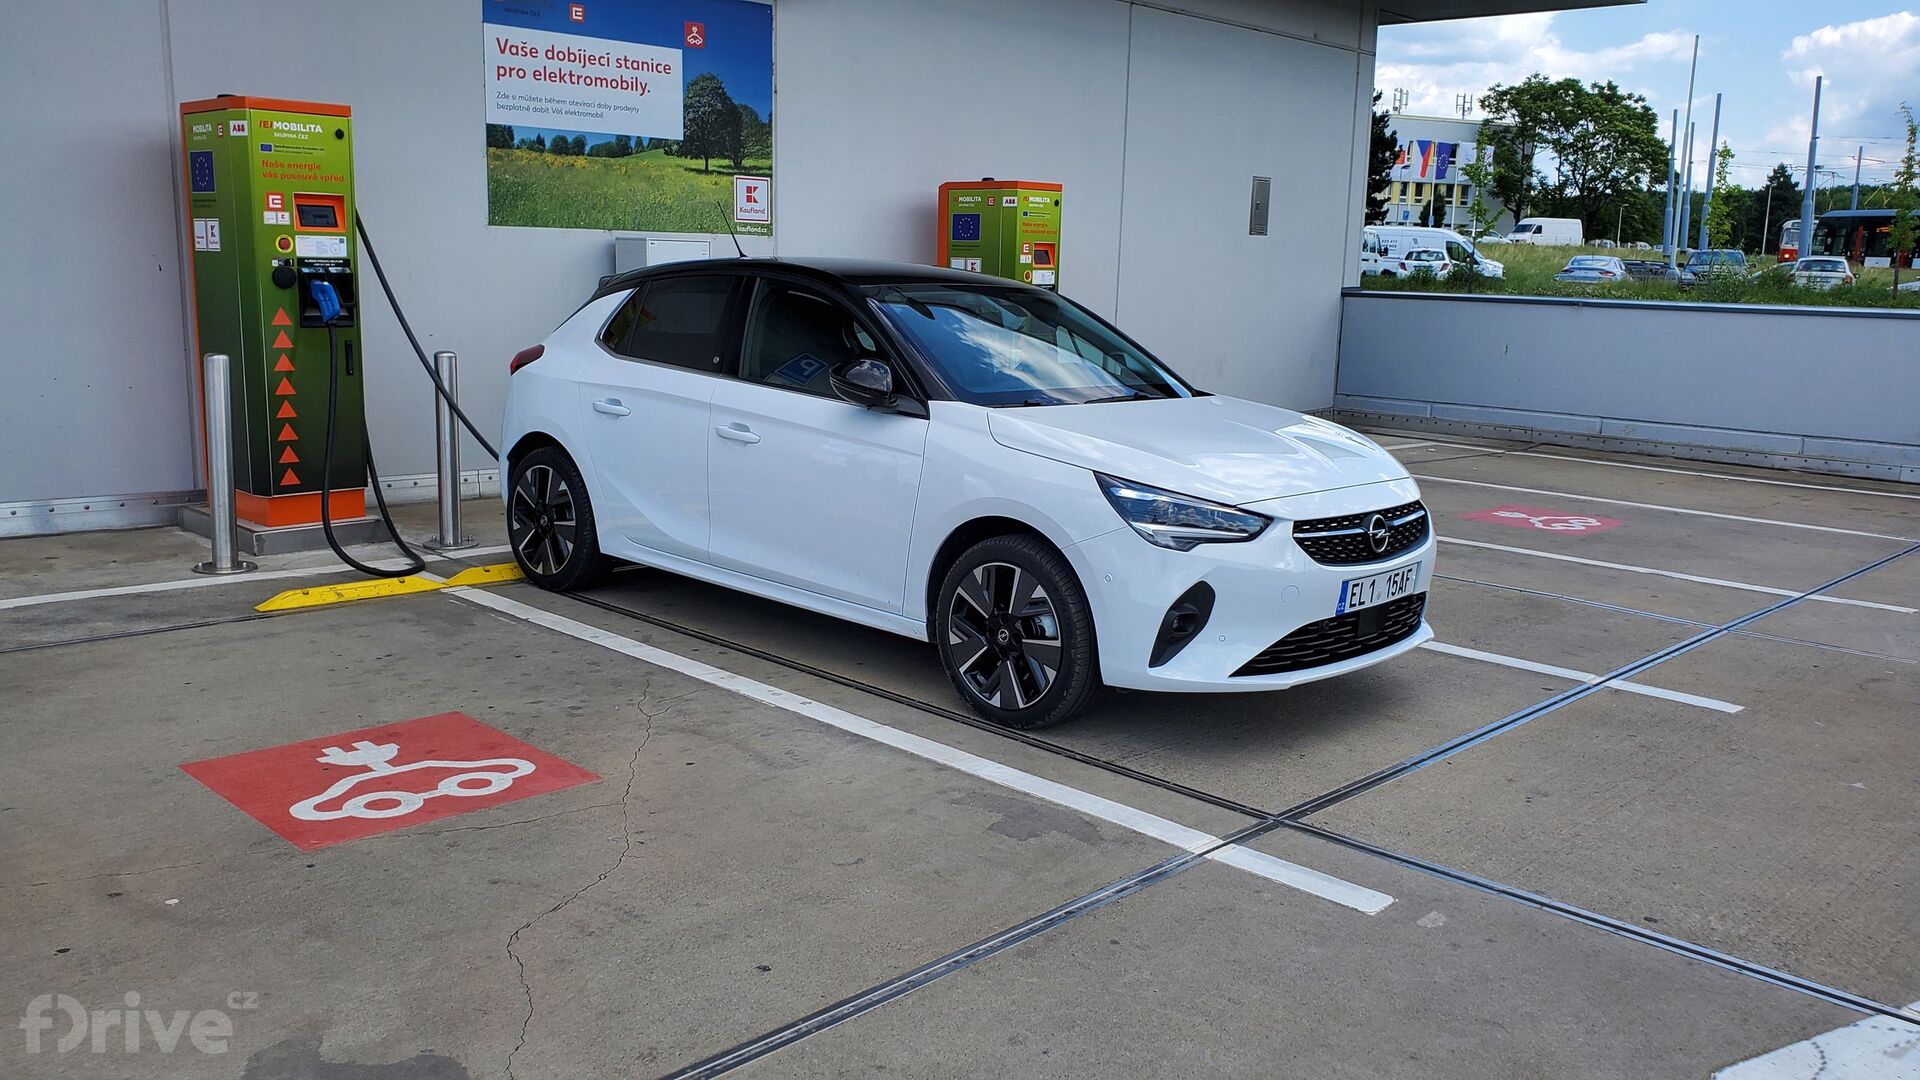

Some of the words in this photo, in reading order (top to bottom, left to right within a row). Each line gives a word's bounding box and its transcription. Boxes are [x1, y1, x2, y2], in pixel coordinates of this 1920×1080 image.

[496, 37, 538, 58] Vaše
[544, 44, 611, 68] dobíjecí
[615, 55, 672, 75] stanice
[496, 65, 527, 81] pro
[532, 65, 651, 96] elektromobily.
[496, 91, 510, 100] Zde
[511, 92, 517, 100] si
[518, 94, 543, 104] můžete
[544, 94, 567, 106] během
[597, 100, 612, 111] doby
[613, 103, 640, 114] prodejny
[232, 124, 245, 132] ABB
[287, 162, 321, 171] energie
[739, 206, 766, 215] Kaufland
[736, 224, 768, 233] kaufland.cz
[1349, 579, 1376, 608] EL1
[1386, 568, 1412, 598] 15AF
